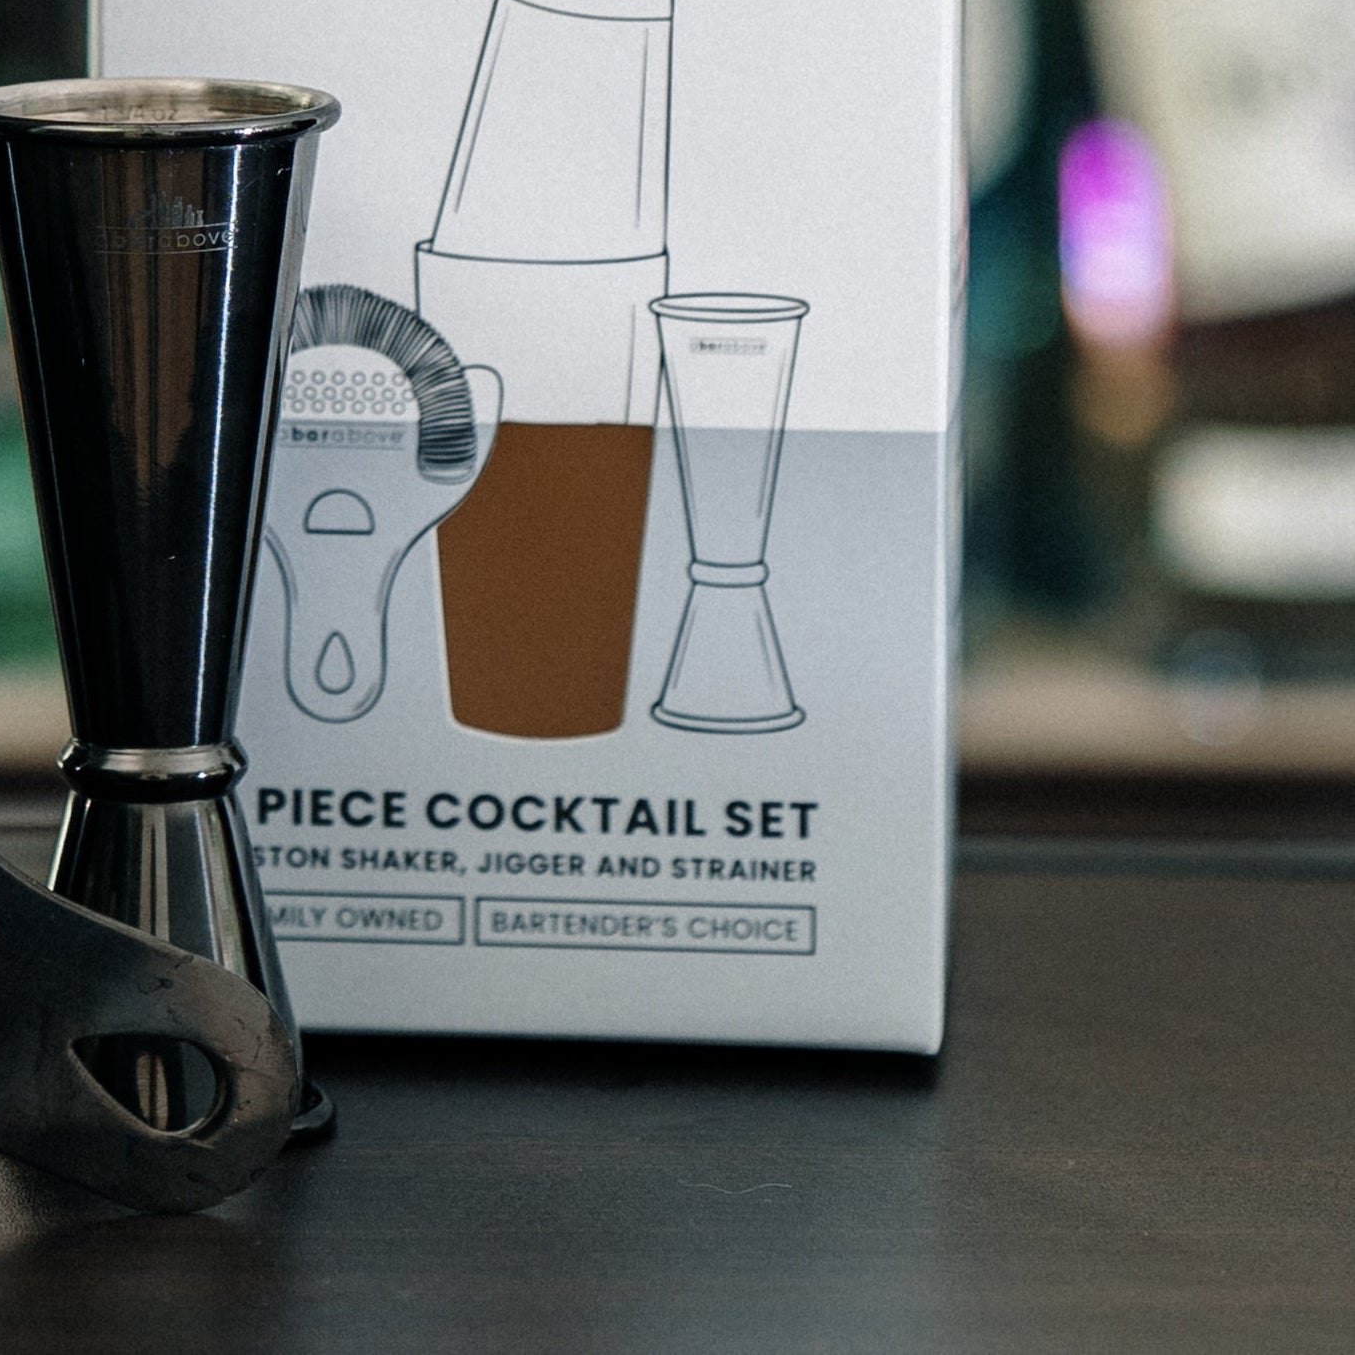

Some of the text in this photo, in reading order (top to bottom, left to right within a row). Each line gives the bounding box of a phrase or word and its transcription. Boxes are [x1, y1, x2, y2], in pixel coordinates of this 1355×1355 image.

[257, 787, 819, 839] PIECE COCKTAIL SET
[252, 846, 817, 883] STON SHAKER, JIGGER AND STRAINER
[267, 906, 443, 931] MILY OWNED
[491, 912, 801, 942] BARTENDER'S CHOICE
